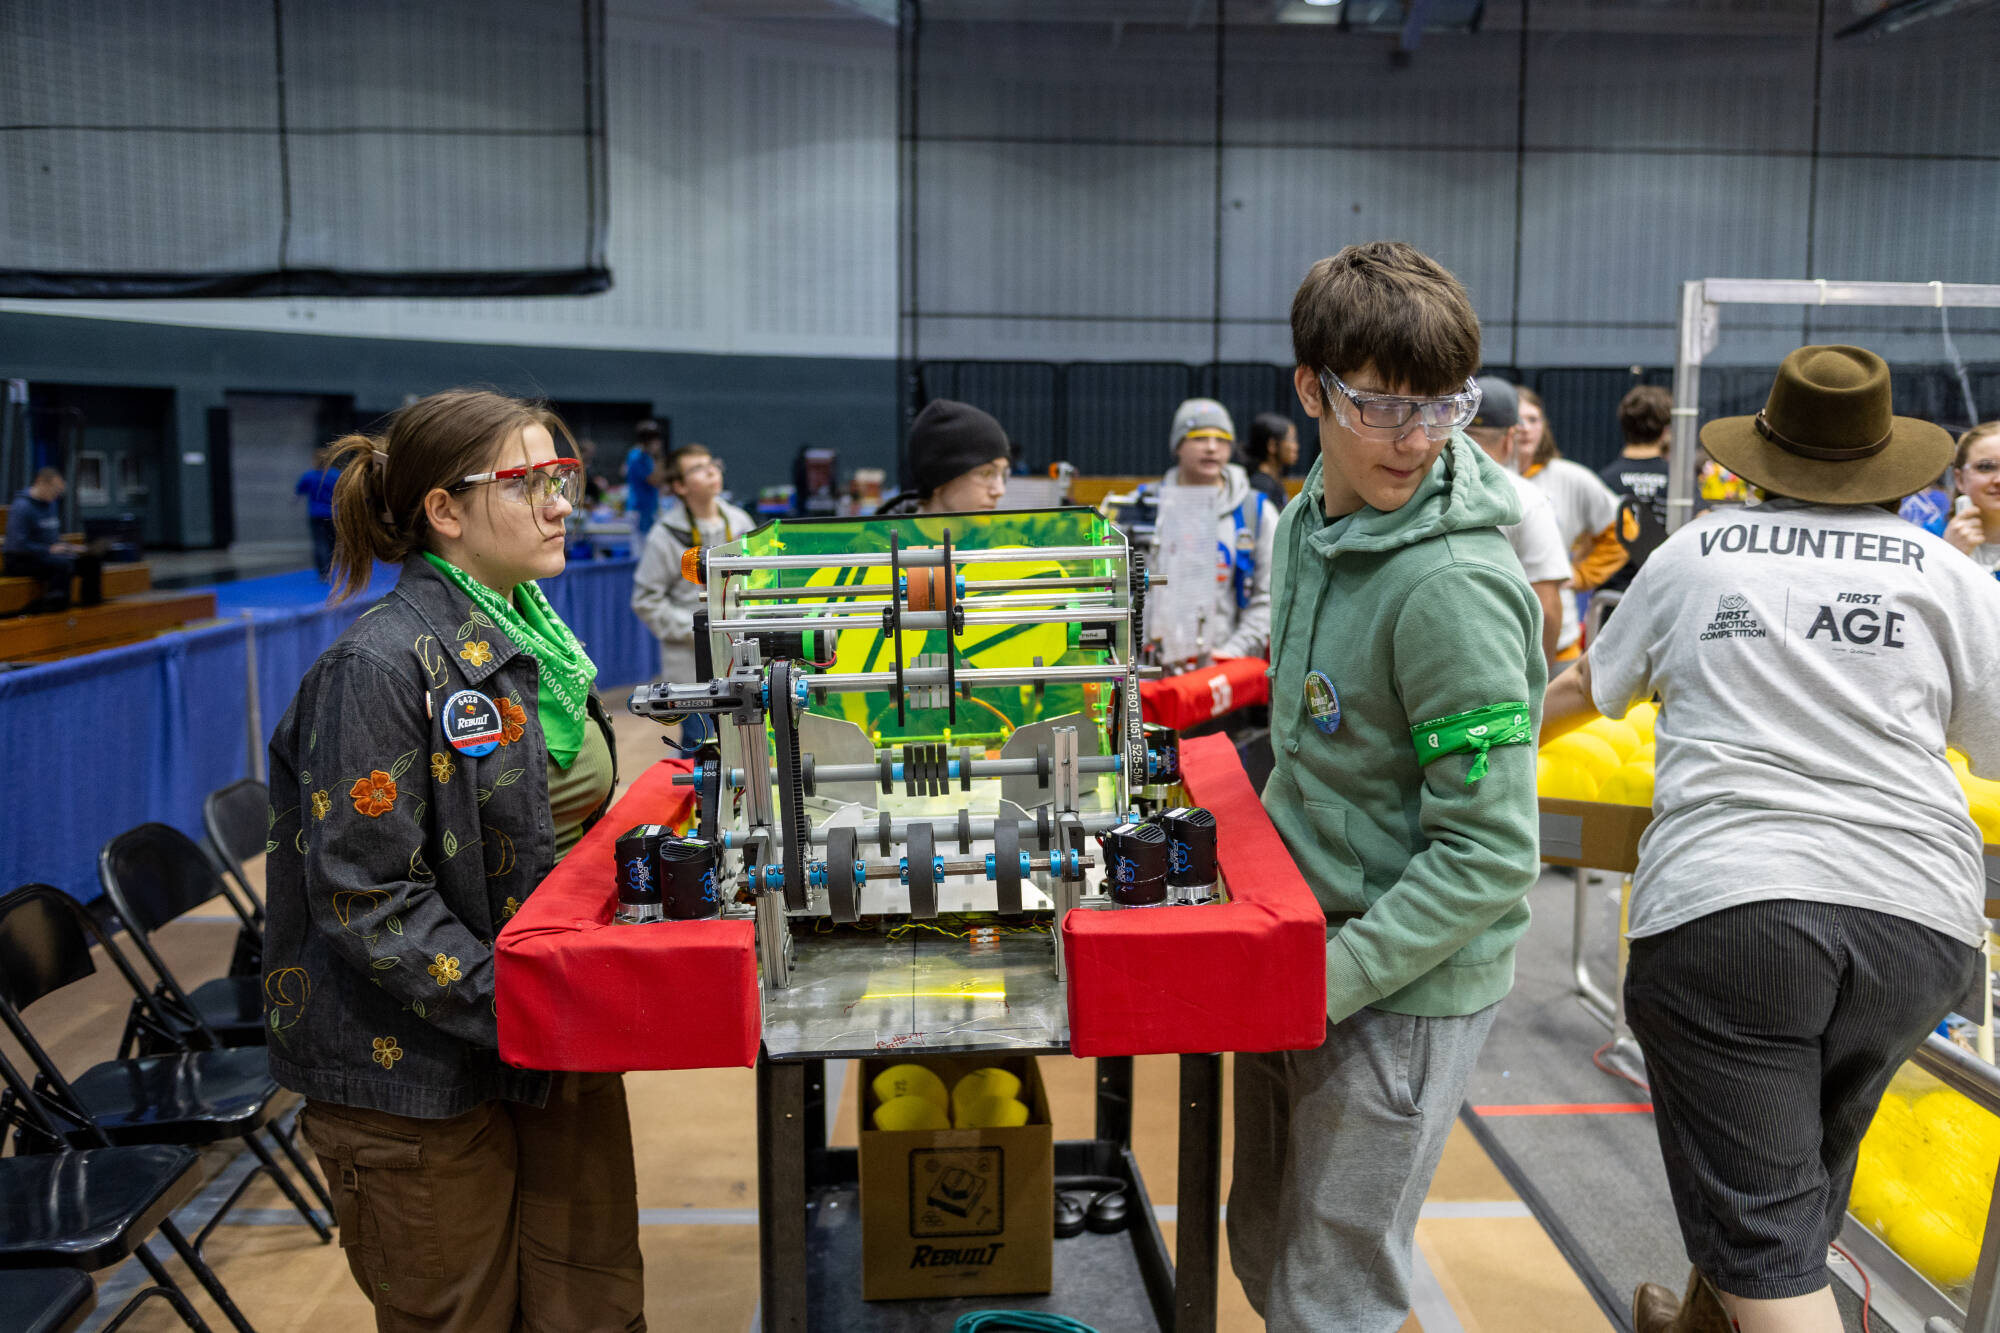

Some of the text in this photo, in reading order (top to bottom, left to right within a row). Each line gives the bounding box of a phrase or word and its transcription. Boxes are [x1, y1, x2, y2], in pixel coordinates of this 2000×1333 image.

[1700, 524, 1925, 573] VOLUNTEER
[1836, 592, 1882, 605] FIRST
[1714, 610, 1748, 622] FIRST
[1707, 619, 1757, 631] ROBOTICS
[1805, 605, 1905, 649] AGE
[1699, 628, 1766, 641] COMPETITION
[458, 695, 478, 706] 6428
[457, 713, 490, 730] REBUILT
[1130, 718, 1141, 739] 105T
[461, 735, 495, 747] TECHNICIAN
[636, 857, 647, 892] KRAKEN
[909, 1243, 1005, 1269] REBUILT
